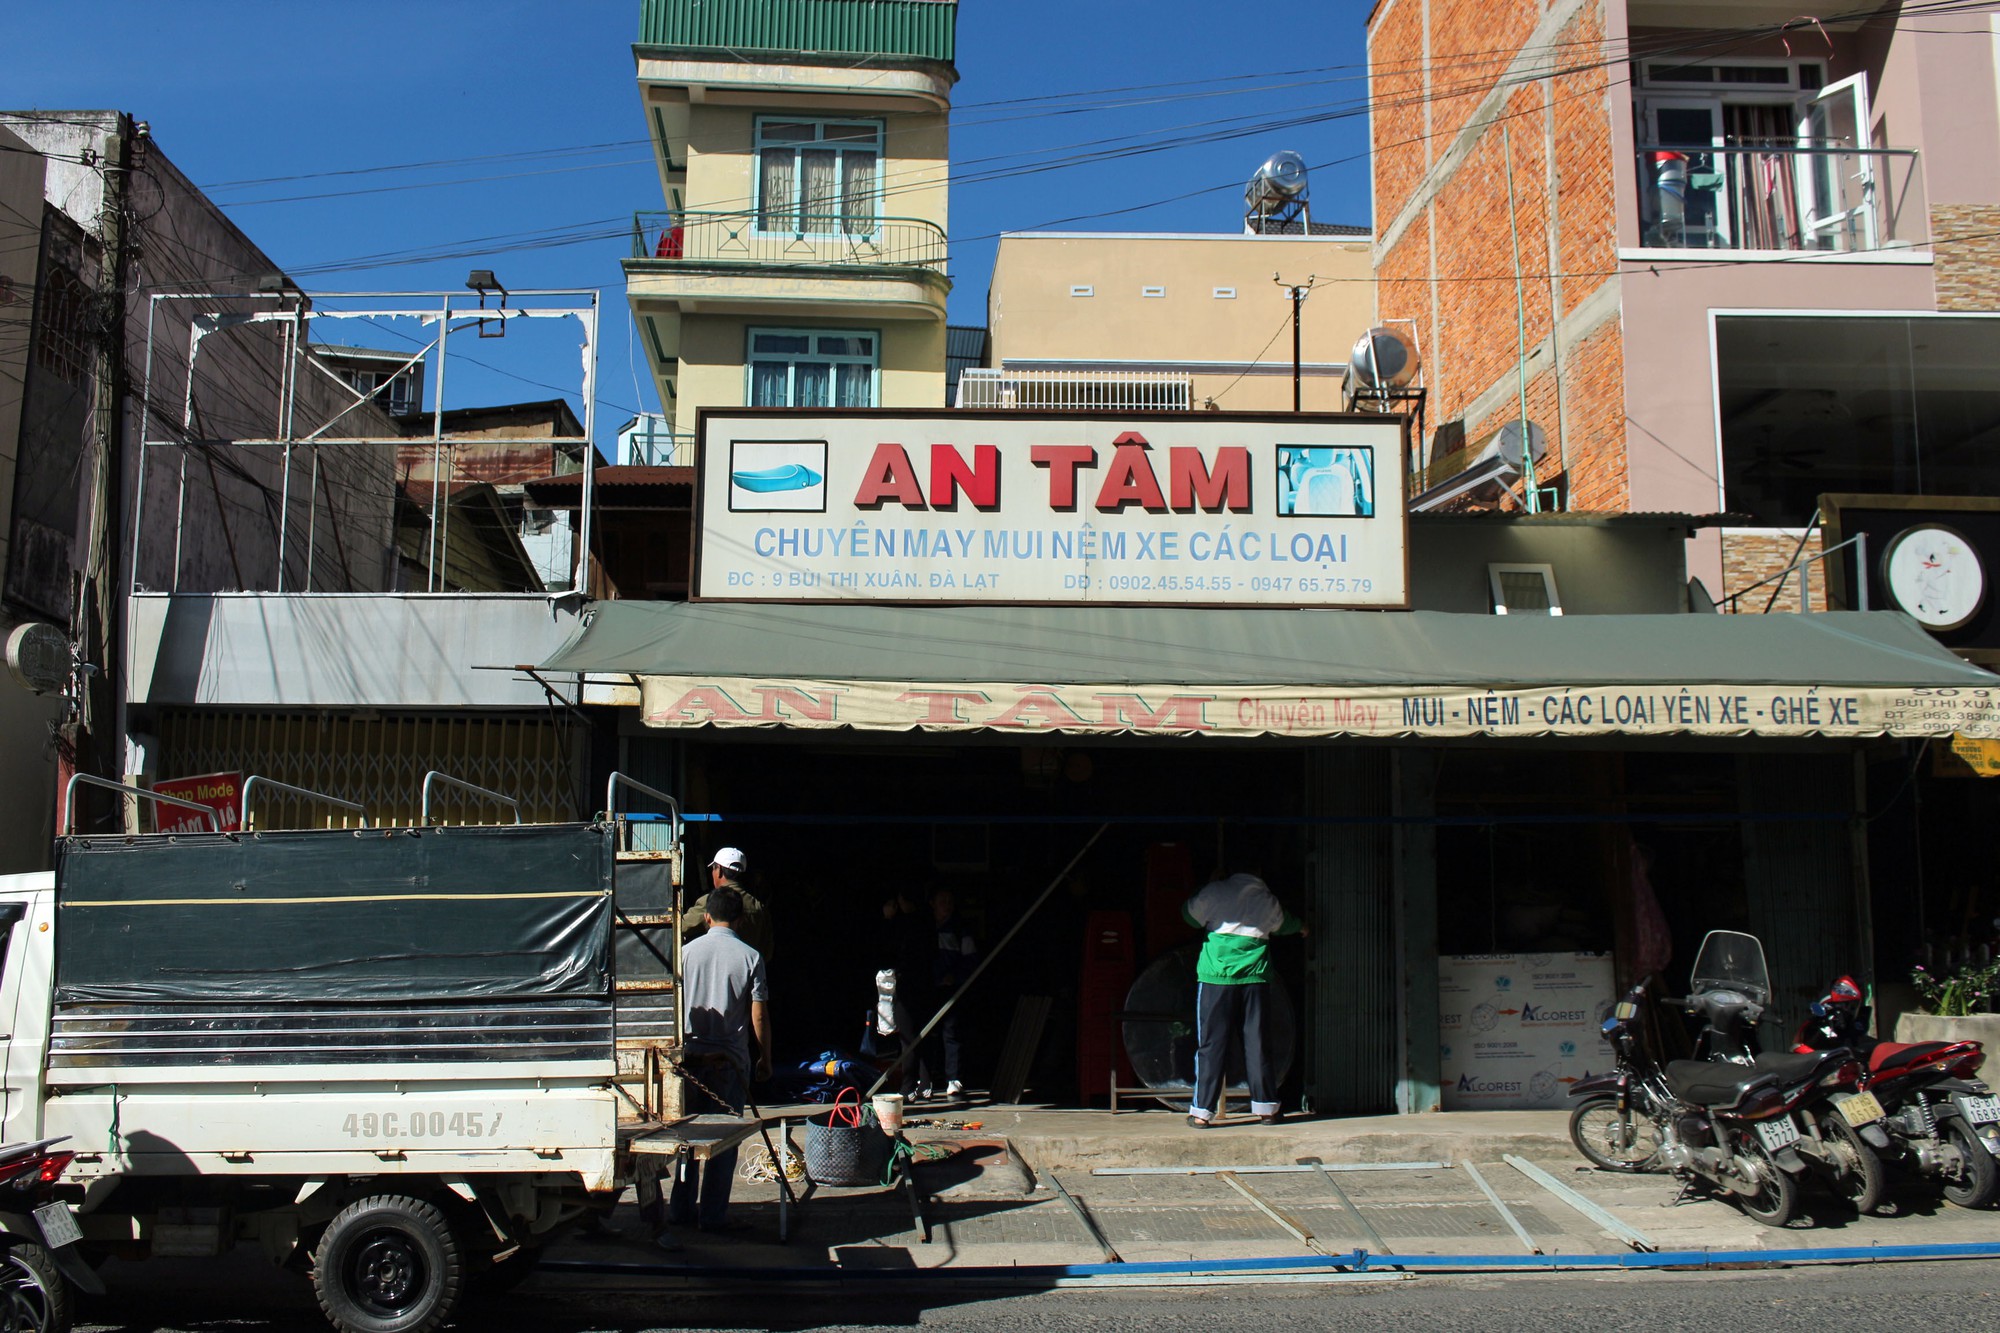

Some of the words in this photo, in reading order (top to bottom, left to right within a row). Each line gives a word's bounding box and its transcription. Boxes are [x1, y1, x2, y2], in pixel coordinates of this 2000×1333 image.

[854, 443, 1001, 512] AN
[1030, 431, 1253, 514] TÂM
[754, 520, 895, 558] CHUYÊN
[903, 528, 977, 559] MAY
[984, 529, 1042, 560] MUI
[1052, 523, 1126, 567] NỆM
[1136, 531, 1179, 561] XE
[1189, 524, 1261, 562] CÁC
[1270, 532, 1347, 569] LOẠI
[727, 571, 754, 586] ĐC
[772, 572, 782, 586] 9
[789, 568, 821, 587] BÙI
[828, 572, 858, 591] THỊ
[929, 569, 956, 588] ĐÀ
[963, 574, 1000, 591] LẠT
[1109, 575, 1232, 590] 0902.45.54.55
[1973, 689, 1990, 698] 9
[648, 685, 849, 721] AN
[895, 684, 1217, 730] TÂM
[1237, 697, 1325, 734] Chuyên
[1334, 698, 1379, 734] May
[1402, 697, 1444, 727] MUI
[1468, 688, 1519, 732] NỆM
[1543, 687, 1592, 725] CÁC
[1601, 695, 1655, 730] LOẠI
[1662, 688, 1710, 724] YÊN
[1718, 696, 1749, 724] XE
[1771, 685, 1820, 725] GHẾ
[1829, 697, 1860, 725] XE
[1963, 699, 2000, 710] XUÂ
[197, 782, 234, 800] Mode
[1521, 1002, 1586, 1021] ALCOREST
[1457, 1072, 1522, 1092] ALCOREST
[1769, 1127, 1795, 1149] 1727
